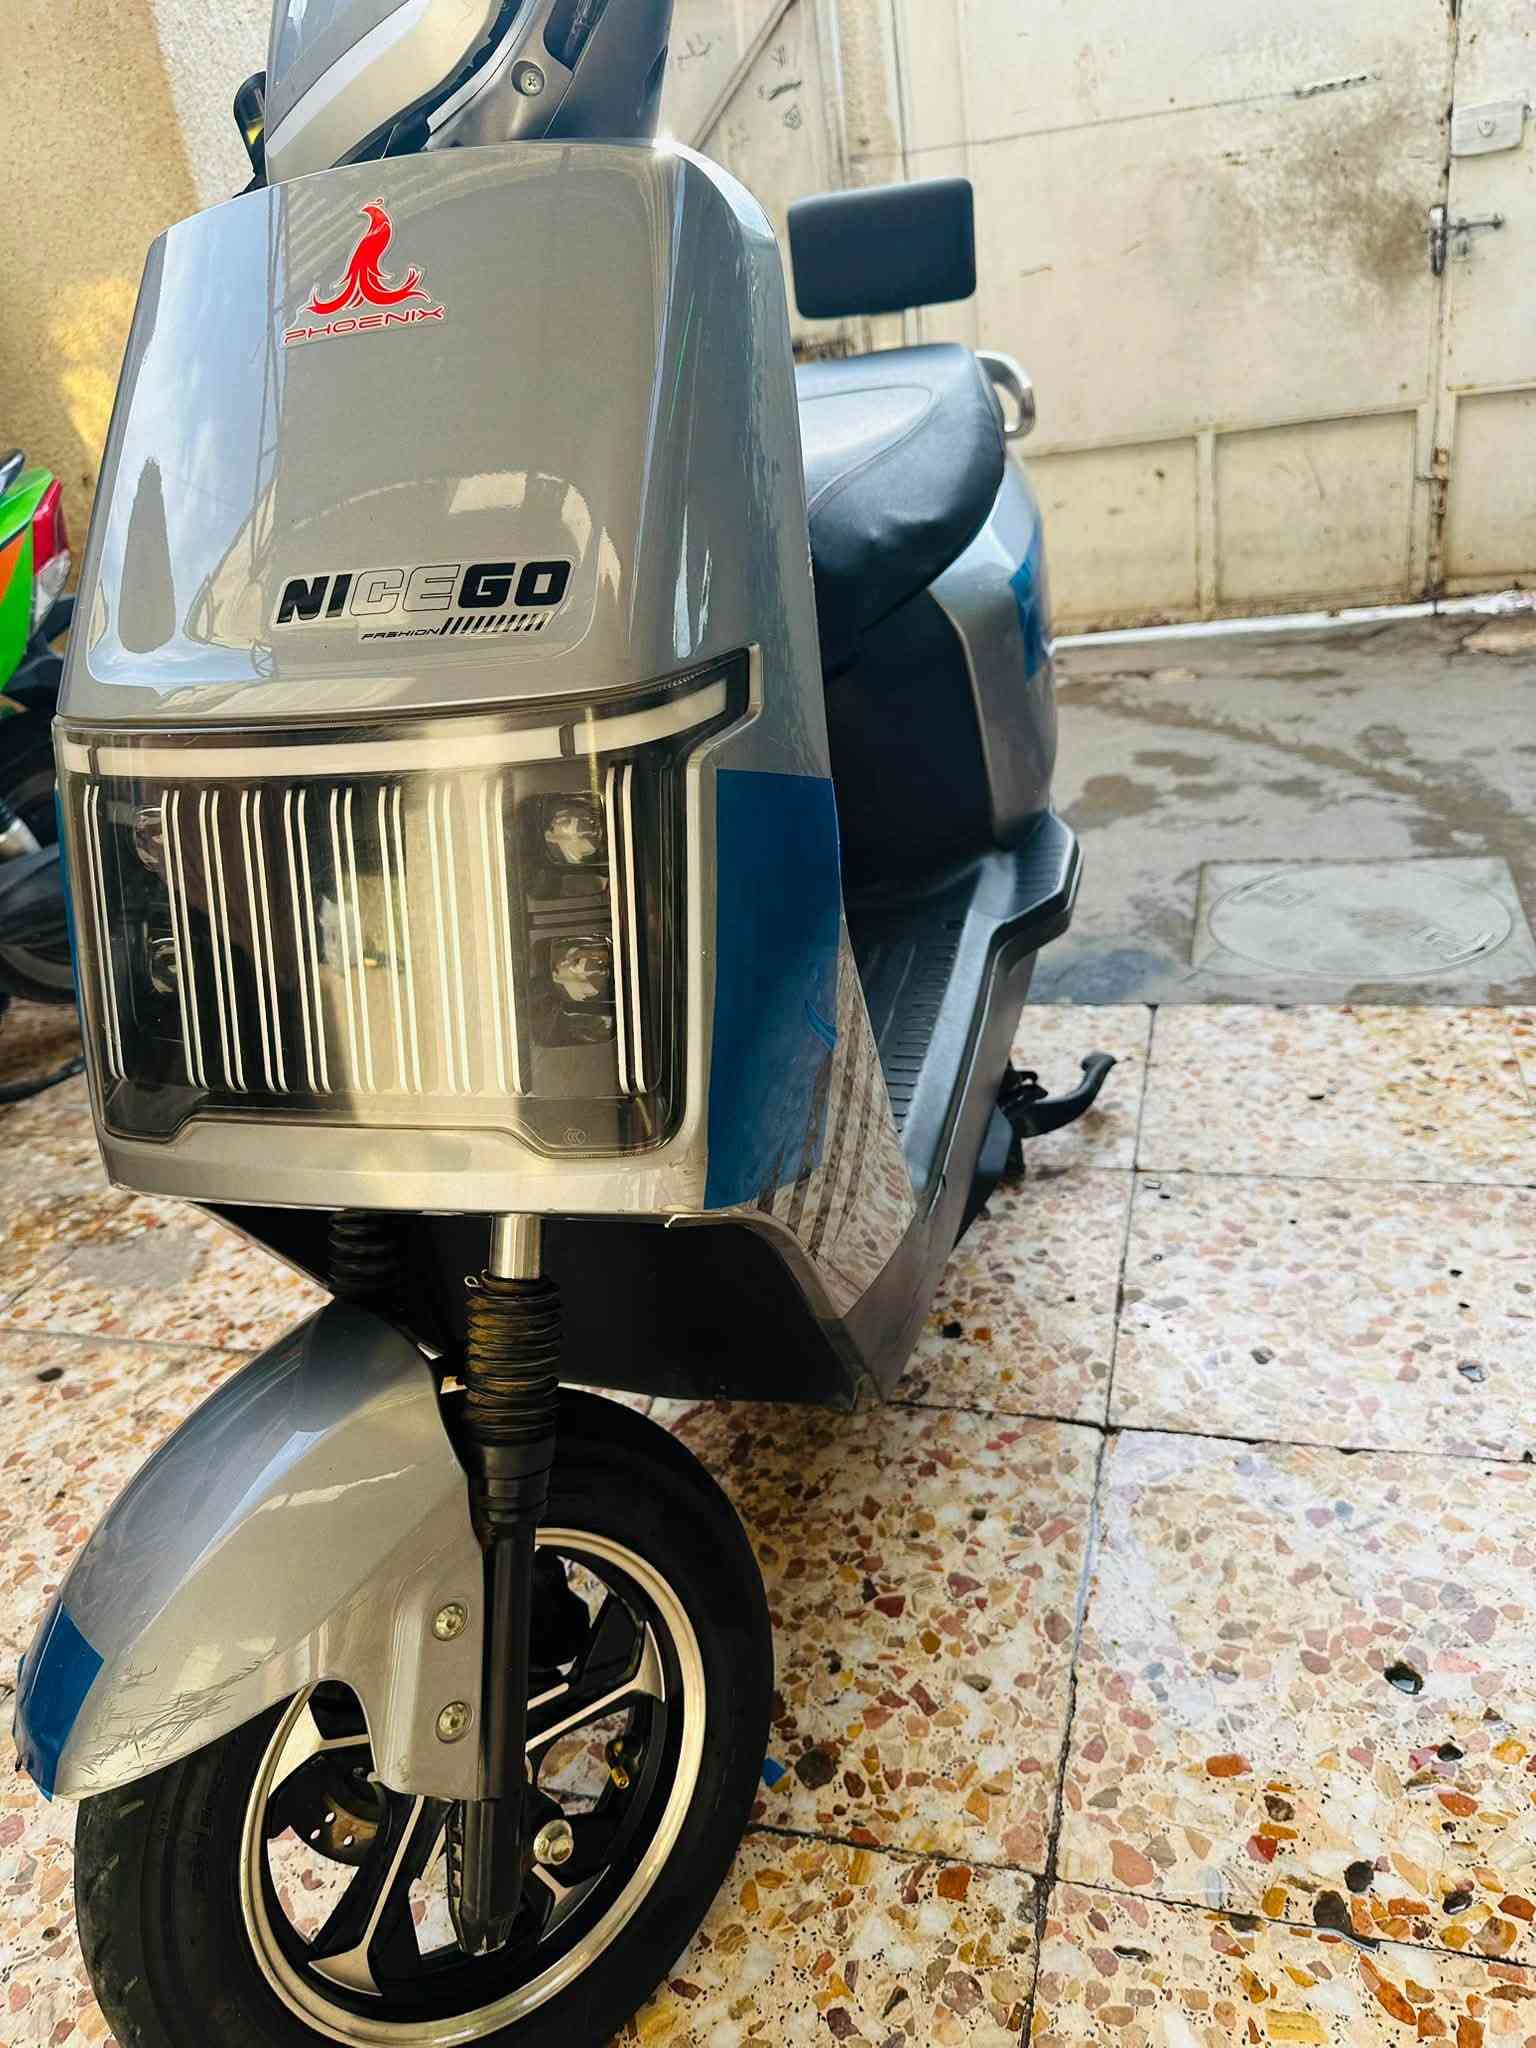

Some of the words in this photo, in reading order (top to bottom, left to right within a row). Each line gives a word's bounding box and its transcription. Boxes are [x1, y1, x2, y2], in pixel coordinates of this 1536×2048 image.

[283, 306, 445, 343] PHOENIX
[276, 560, 571, 624] NICEGO
[361, 627, 441, 640] FASHION
